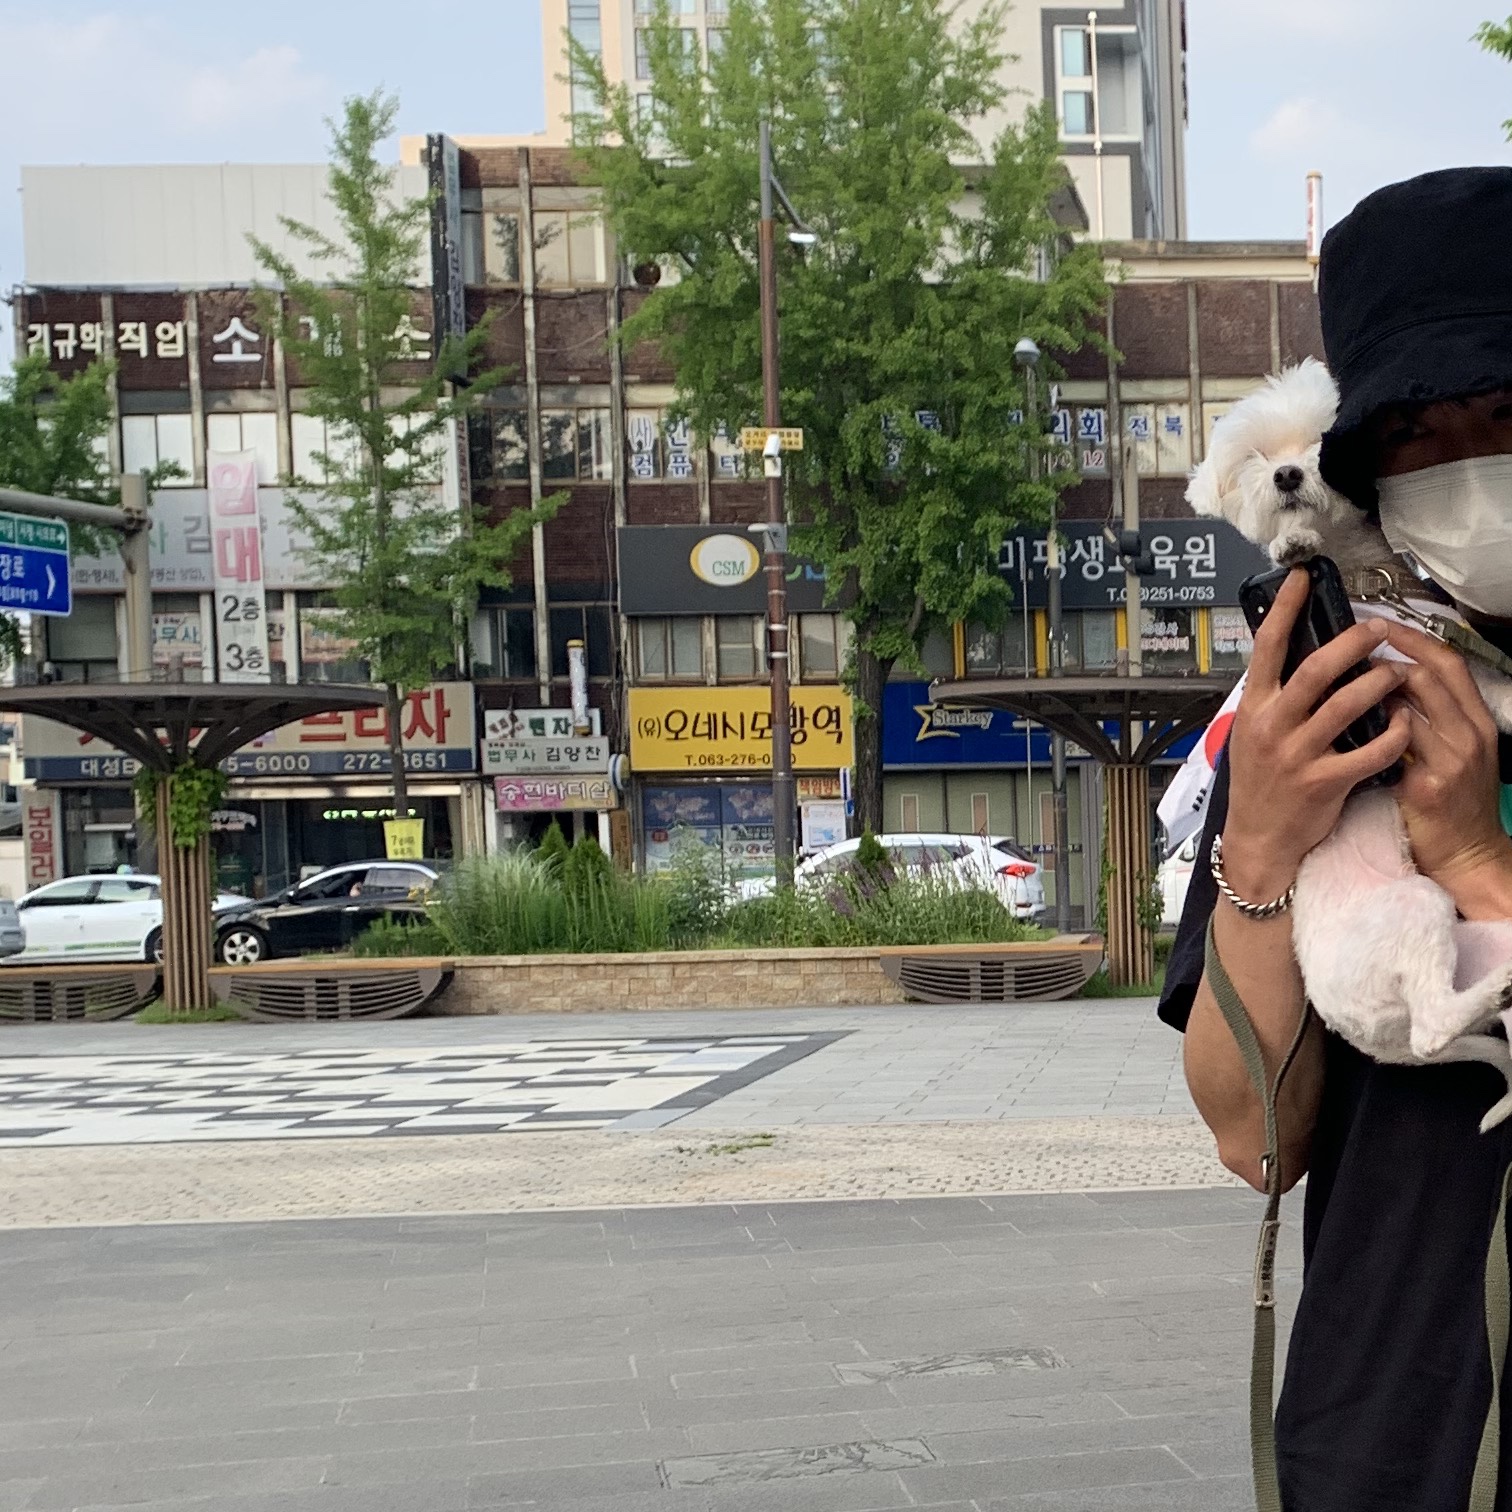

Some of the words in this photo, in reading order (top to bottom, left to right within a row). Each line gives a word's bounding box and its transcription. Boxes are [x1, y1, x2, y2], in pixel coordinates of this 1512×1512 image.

[118, 321, 184, 358] 직업
[1130, 415, 1183, 438] 전북
[211, 461, 261, 582] 임대
[711, 560, 745, 577] CSM
[1106, 585, 1215, 602] T.03)251-0753
[222, 595, 261, 622] 2층
[226, 643, 263, 671] 3층
[932, 709, 994, 730] Starkey
[487, 749, 536, 763] 법무사
[546, 746, 601, 763] 김양찬
[684, 754, 796, 767] T.063-276-00
[28, 806, 54, 879] 보일러
